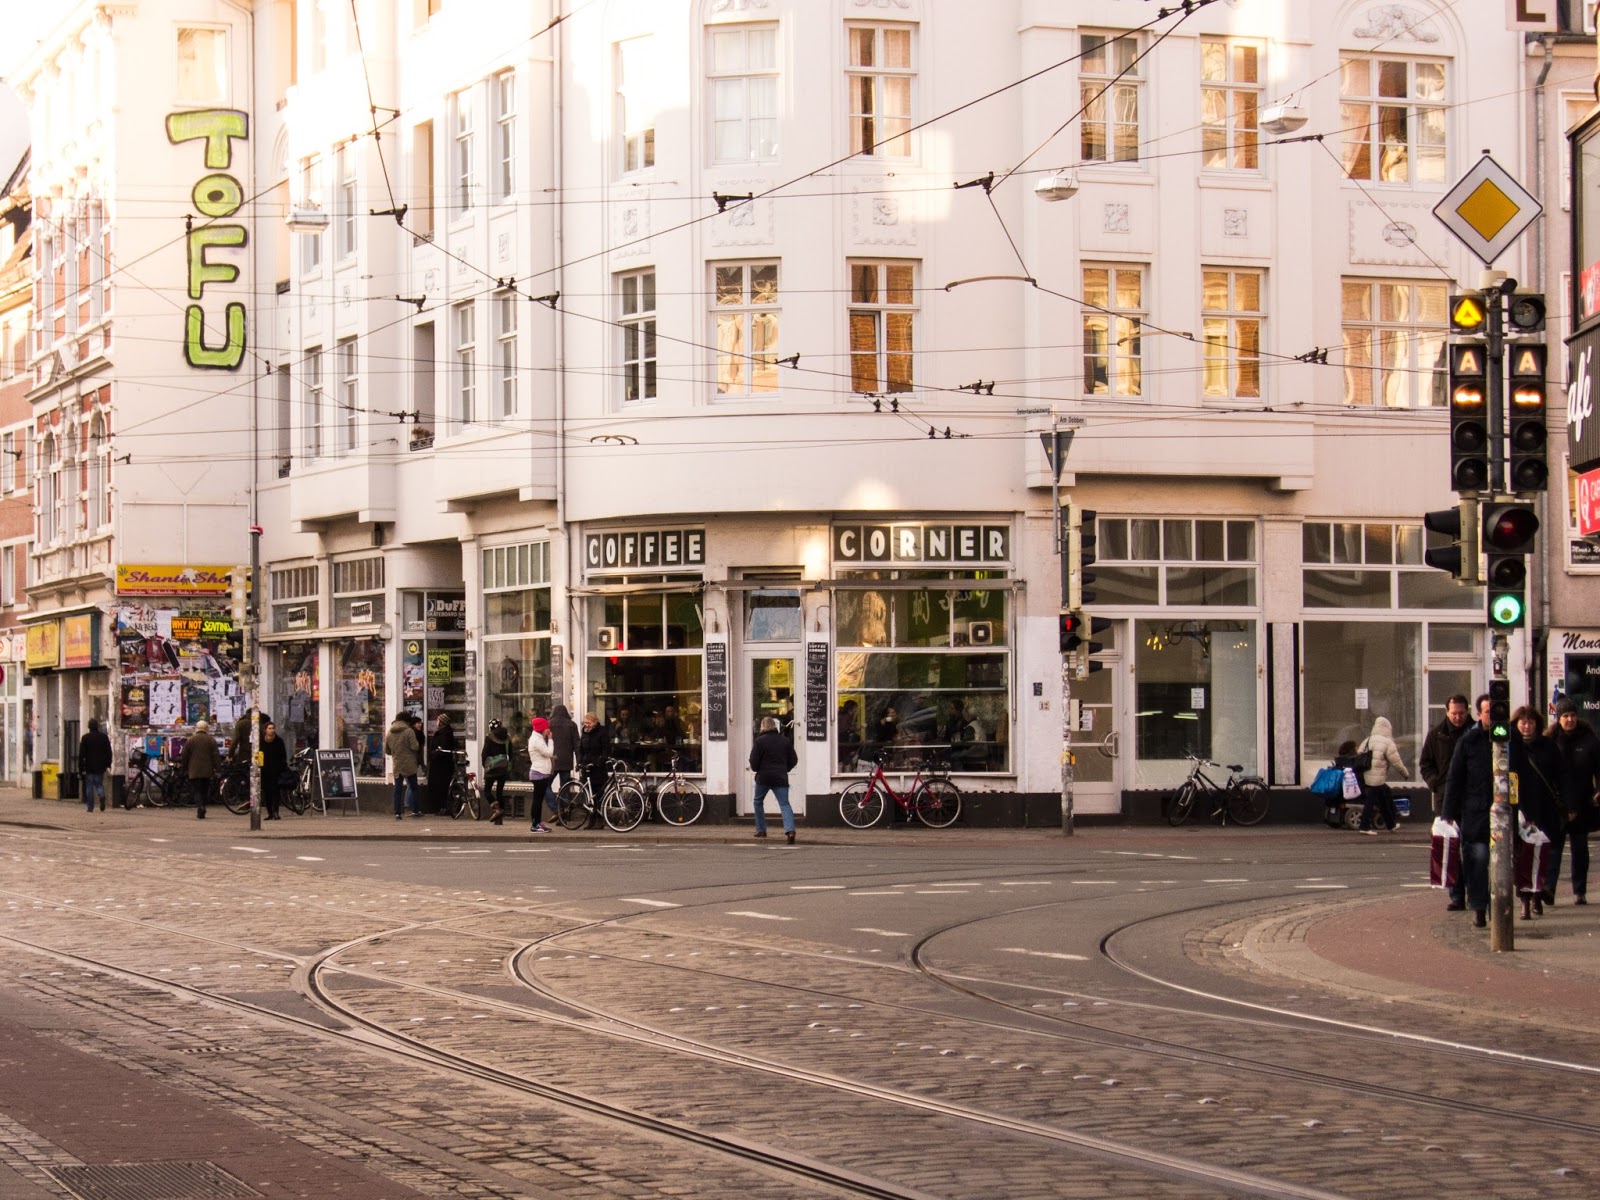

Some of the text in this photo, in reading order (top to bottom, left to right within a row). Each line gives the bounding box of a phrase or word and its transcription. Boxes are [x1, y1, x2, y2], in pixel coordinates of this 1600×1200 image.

[1459, 350, 1478, 372] A
[1518, 350, 1537, 372] A
[1068, 416, 1085, 424] Dobben
[588, 534, 701, 565] COFFEE
[839, 529, 1004, 557] CORNER
[172, 620, 202, 630] WHY NOT
